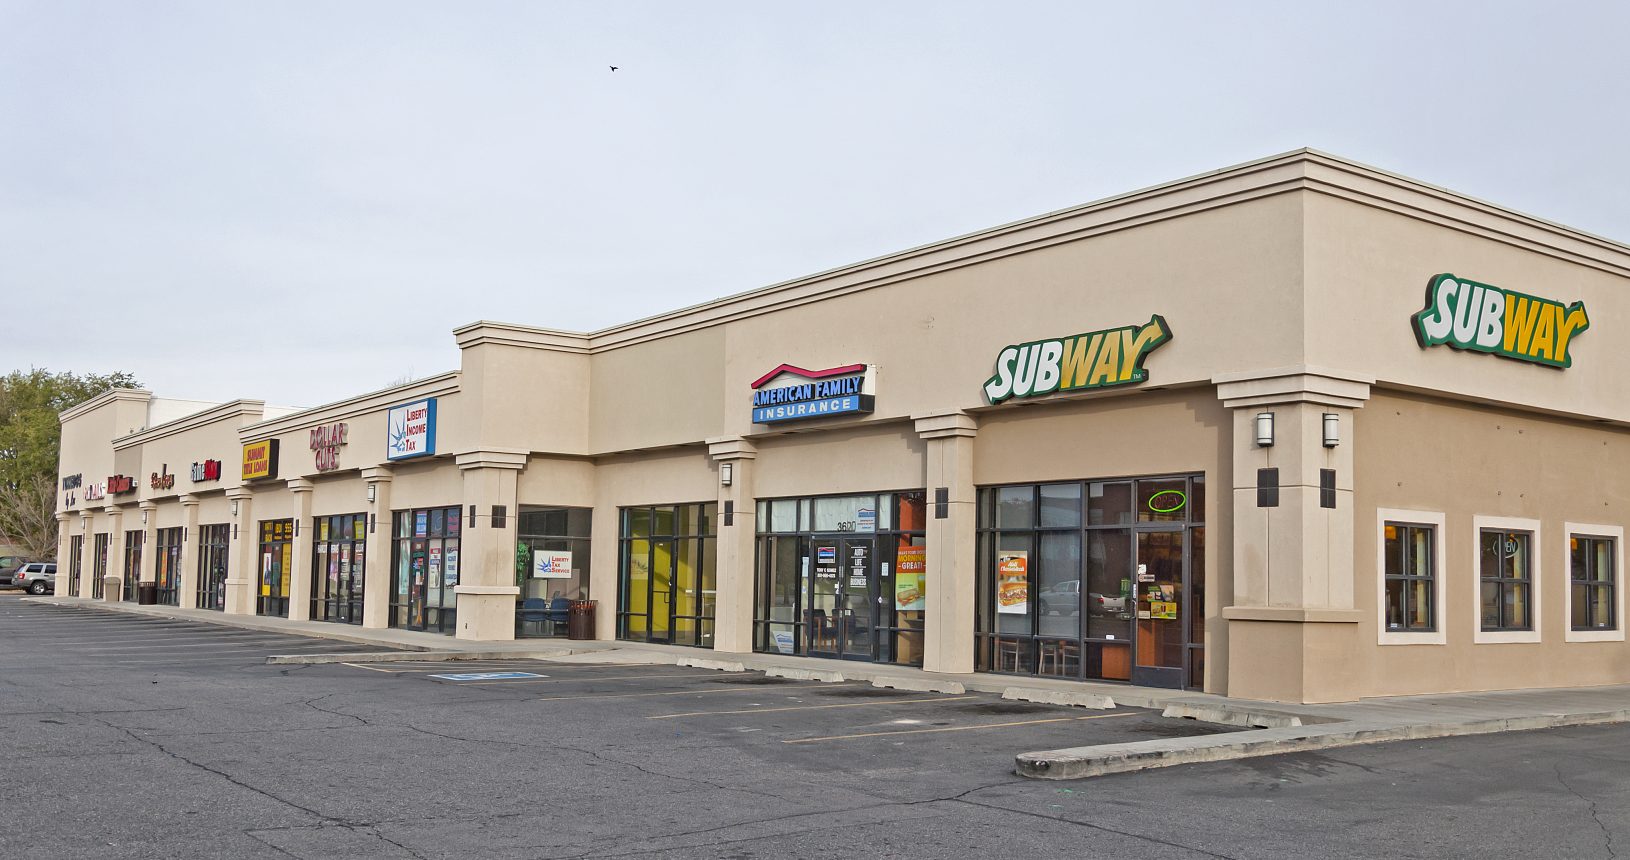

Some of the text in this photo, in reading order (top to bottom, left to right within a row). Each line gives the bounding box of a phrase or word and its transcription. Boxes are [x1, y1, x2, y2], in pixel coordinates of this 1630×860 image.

[1422, 278, 1588, 362] SUBWAY
[984, 321, 1164, 402] SUBWAY
[753, 376, 862, 407] AMERICAN FAMILY
[406, 408, 428, 421] LIBERTY
[760, 399, 851, 420] INSURANCE
[310, 422, 345, 450] DOLLAR
[406, 424, 426, 437] INCOME
[405, 439, 417, 452] TAX
[315, 446, 337, 471] CUTS
[854, 558, 863, 566] LIFE
[898, 554, 927, 562] MORNING
